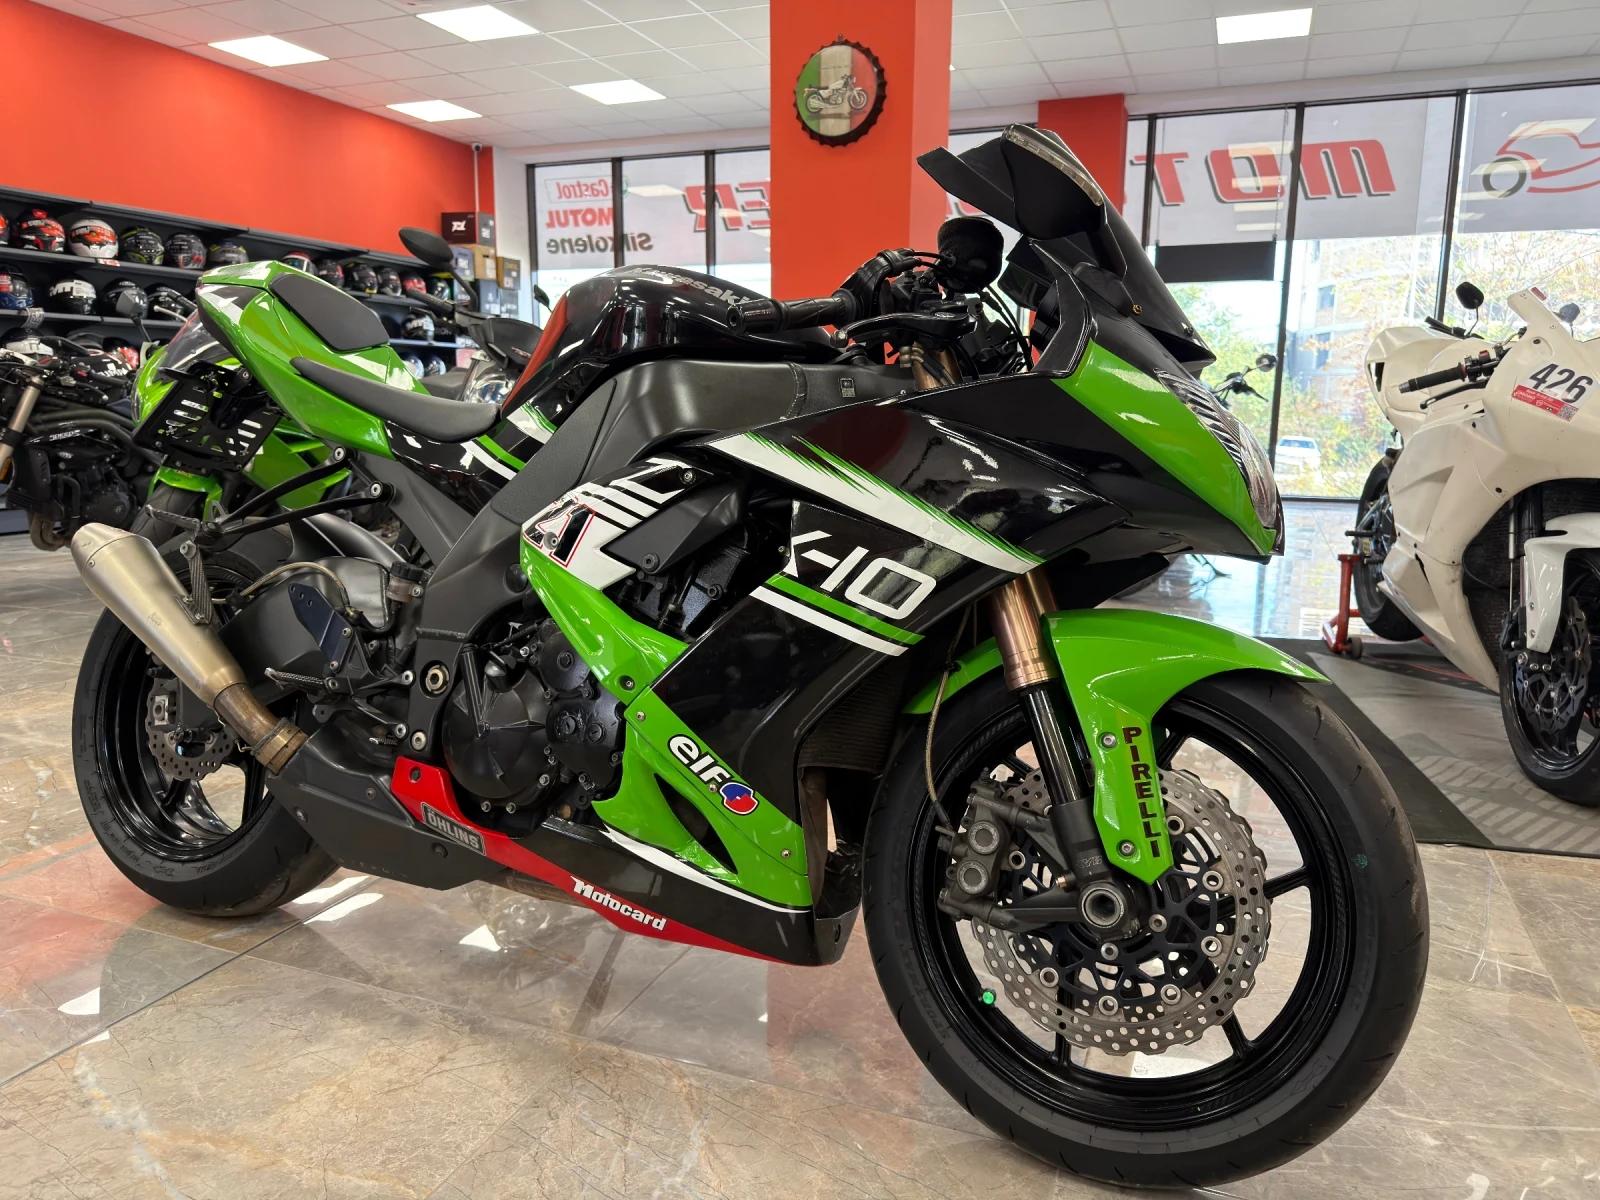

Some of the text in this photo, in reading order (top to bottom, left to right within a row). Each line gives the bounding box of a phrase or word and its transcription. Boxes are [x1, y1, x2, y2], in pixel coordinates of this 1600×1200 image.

[1529, 363, 1593, 403] 426
[669, 735, 731, 783] elf
[1122, 726, 1162, 858] PIRELLI
[427, 808, 480, 850] ÖHLINS
[570, 875, 668, 931] Motocard
